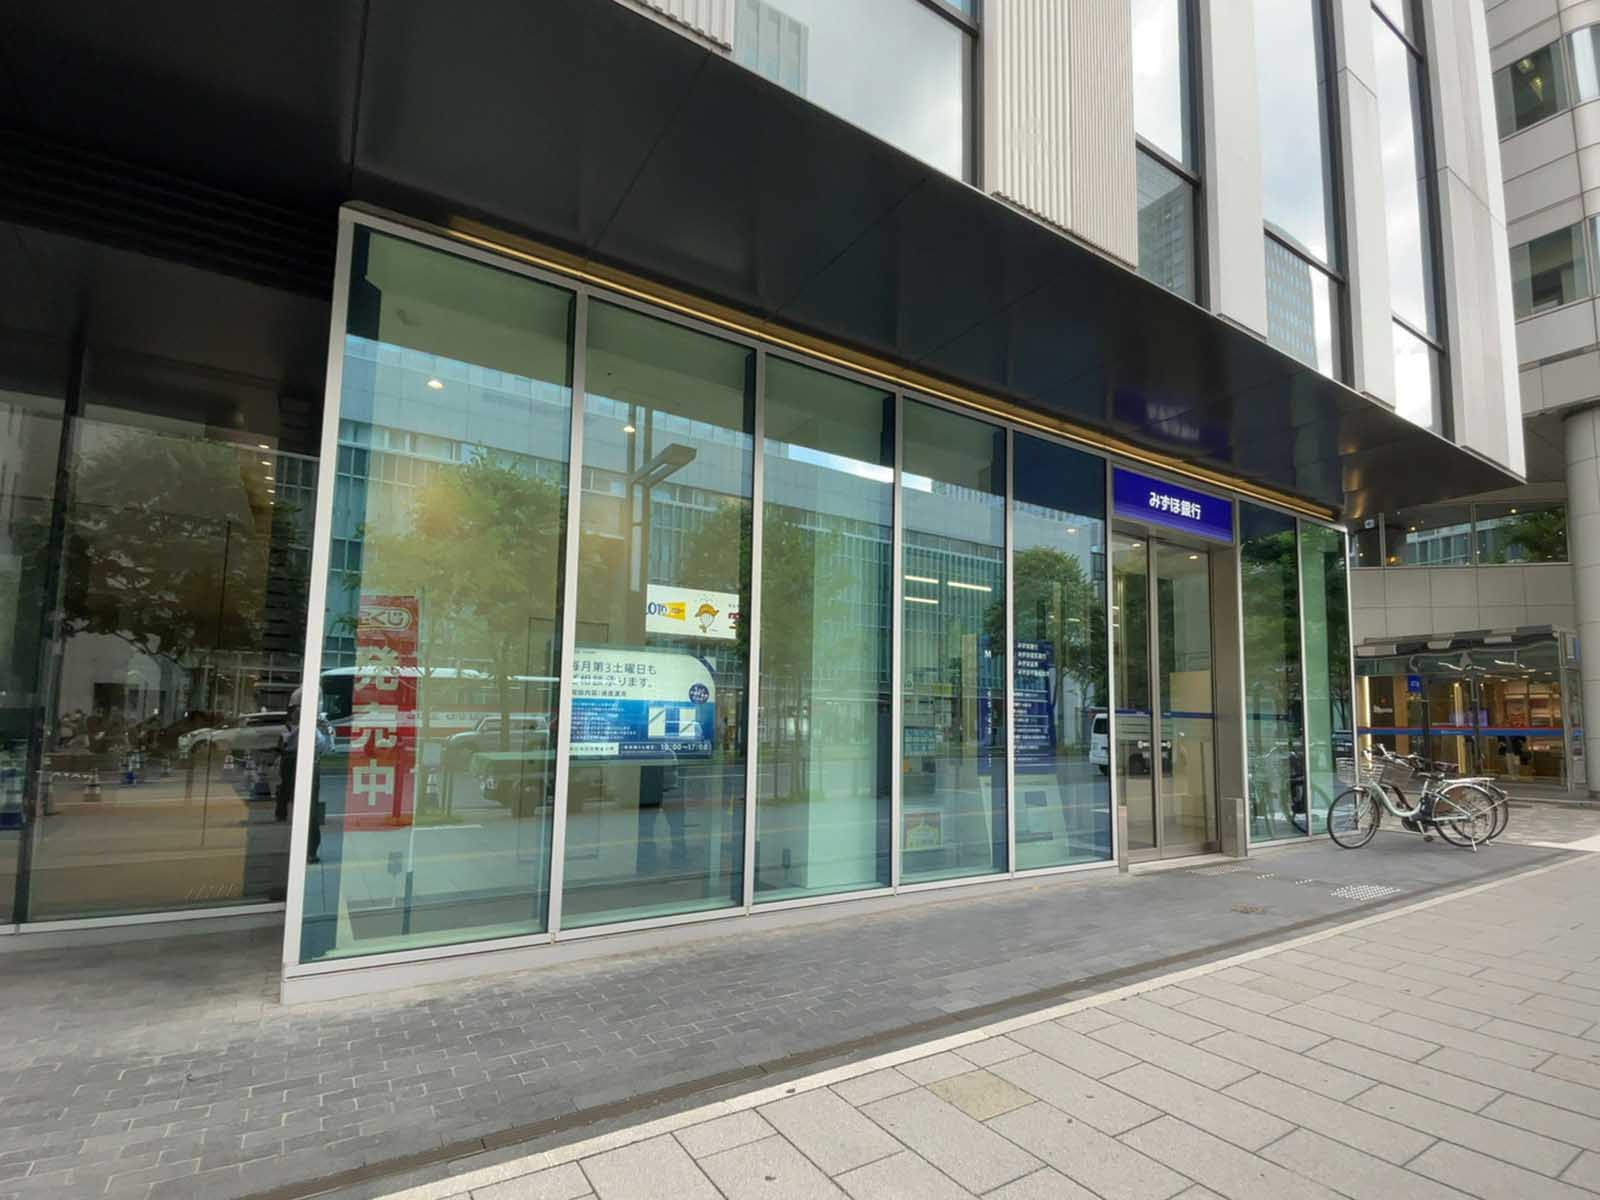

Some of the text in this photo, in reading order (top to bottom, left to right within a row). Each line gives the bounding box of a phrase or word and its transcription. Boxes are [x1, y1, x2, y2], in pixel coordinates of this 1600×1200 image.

[1149, 491, 1201, 520] みずほ銀行
[645, 602, 668, 616] OTO
[351, 645, 401, 806] 発売中
